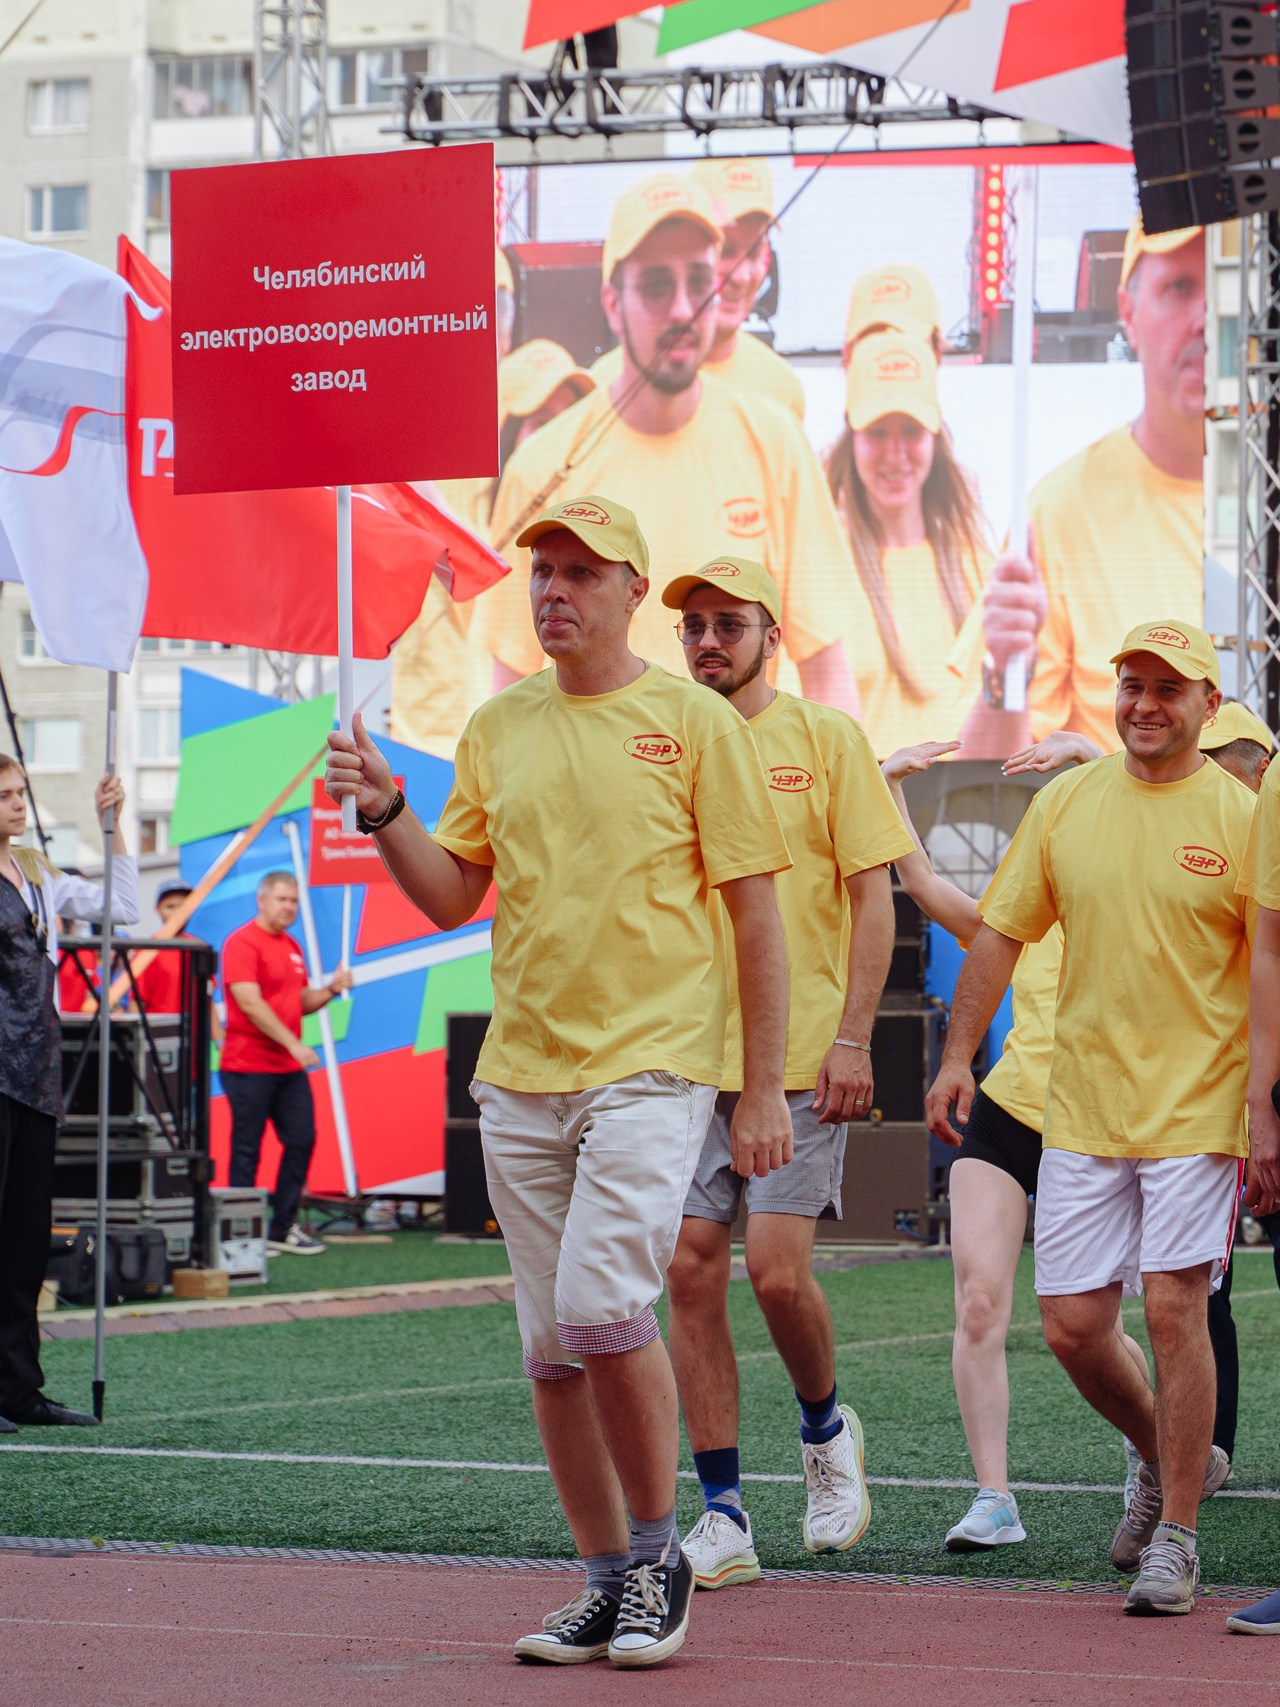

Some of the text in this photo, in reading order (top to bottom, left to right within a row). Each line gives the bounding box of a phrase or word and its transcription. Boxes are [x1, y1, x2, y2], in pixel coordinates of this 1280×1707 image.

[253, 253, 426, 290] Челябинский
[180, 303, 488, 352] электровозоремонтный
[290, 368, 367, 392] завод
